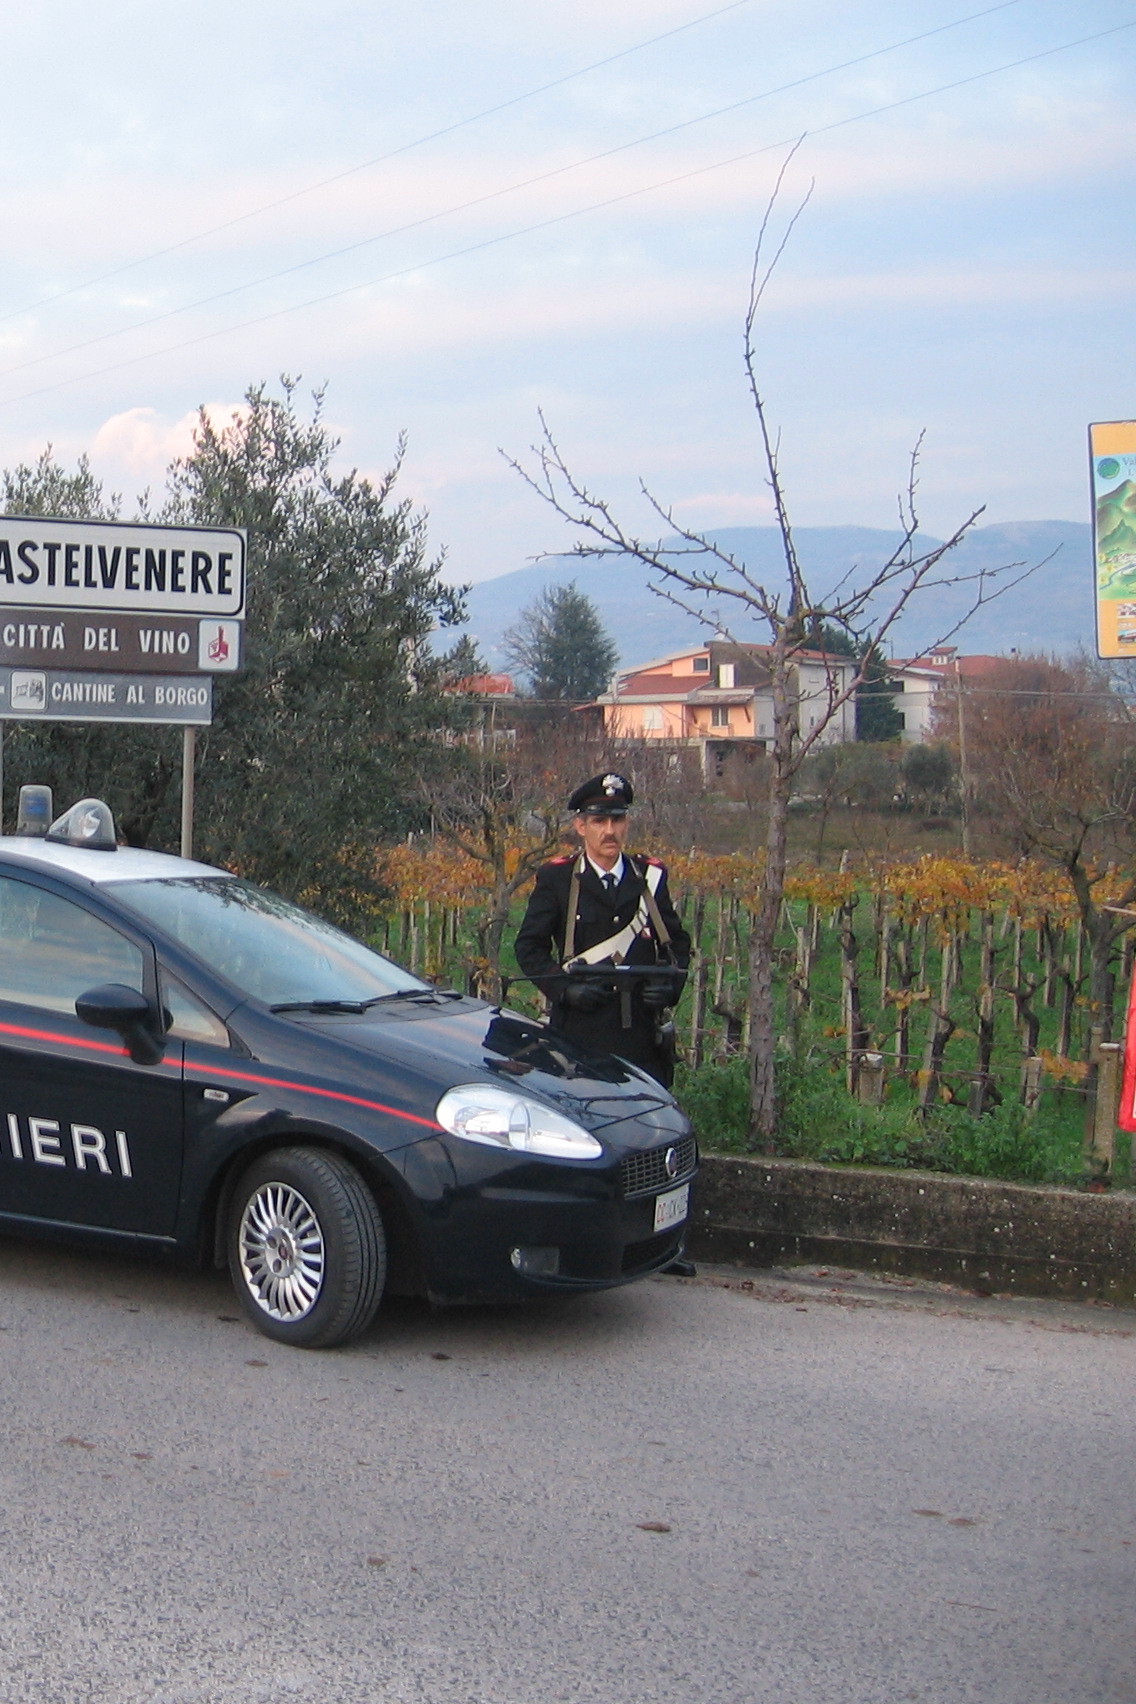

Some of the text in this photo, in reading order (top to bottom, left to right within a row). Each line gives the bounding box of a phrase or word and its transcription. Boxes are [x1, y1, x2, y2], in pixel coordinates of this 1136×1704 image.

[2, 621, 191, 655] CITTÀ DEL VINO
[51, 681, 209, 706] CANTINE AL BORGO
